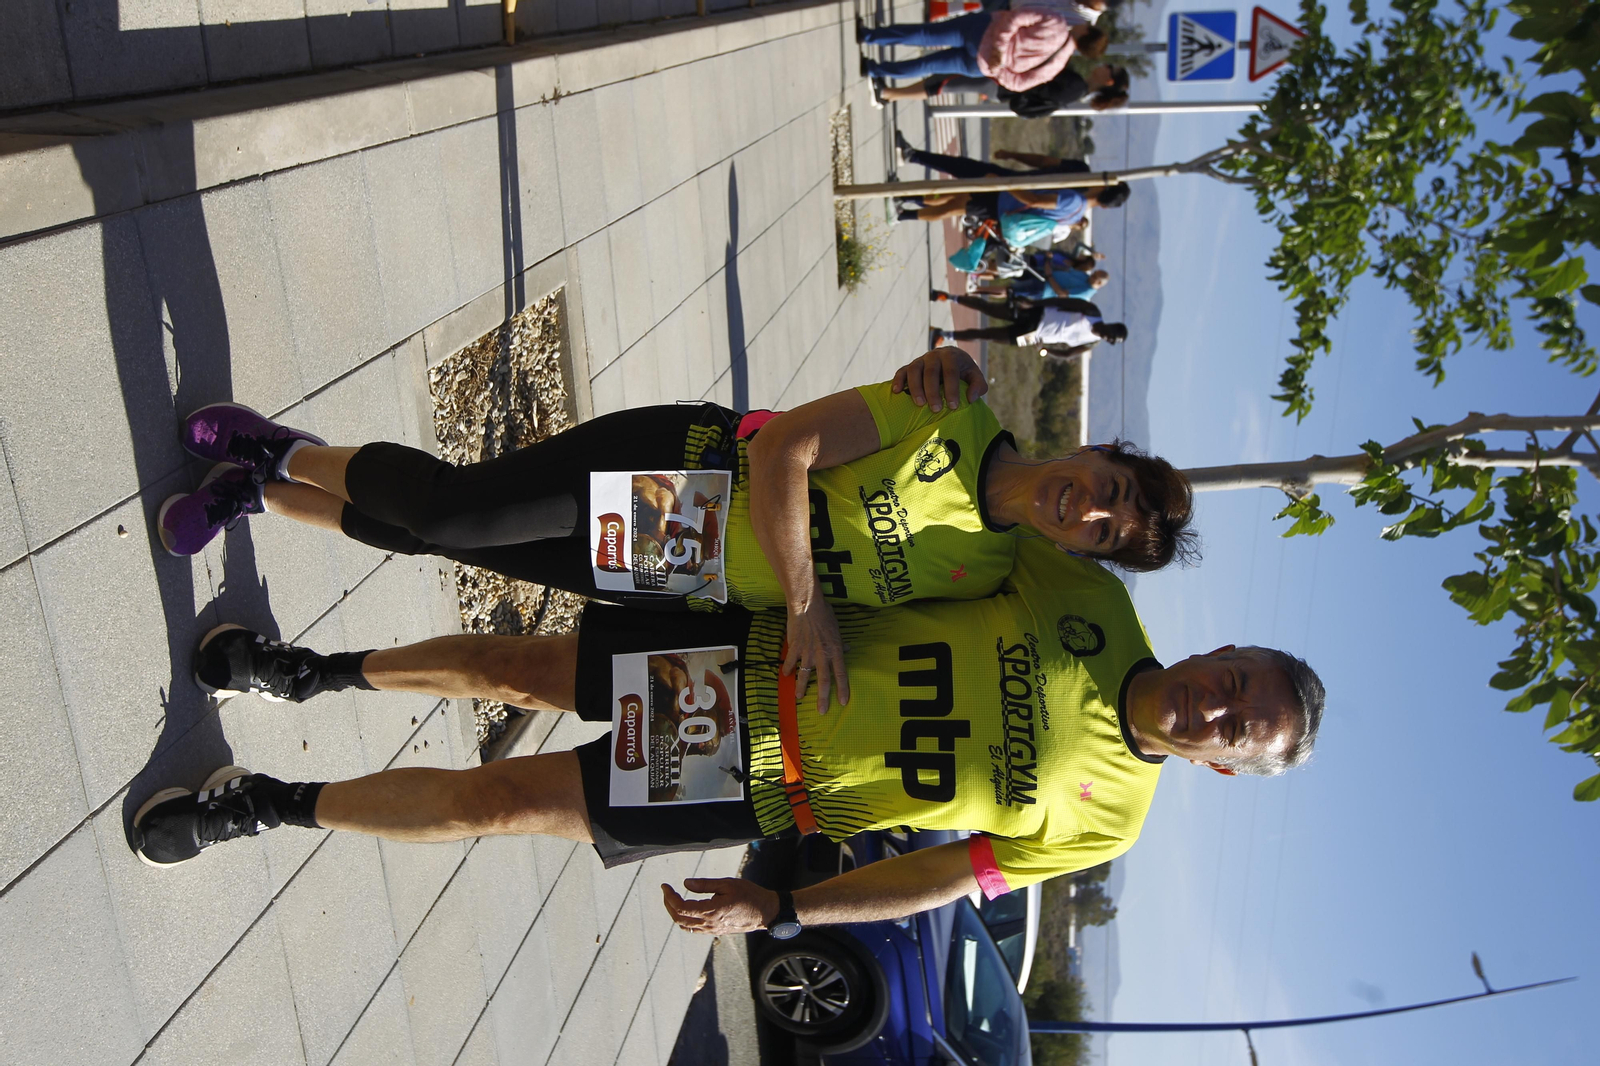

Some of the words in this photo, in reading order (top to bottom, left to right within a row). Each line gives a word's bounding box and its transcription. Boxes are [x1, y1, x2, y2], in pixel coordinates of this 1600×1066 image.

[664, 506, 706, 565] 75
[881, 478, 900, 507] Centro
[896, 508, 915, 548] Deportivo
[656, 555, 666, 586] XIII
[863, 490, 914, 600] SPORTGYM
[869, 569, 882, 579] El
[1024, 633, 1041, 669] Centro
[1034, 674, 1050, 731] Deportivo
[678, 686, 716, 743] 30
[884, 642, 970, 802] mtp
[997, 643, 1037, 804] SPORTGYM
[670, 735, 680, 786] XIII
[988, 745, 1004, 759] El
